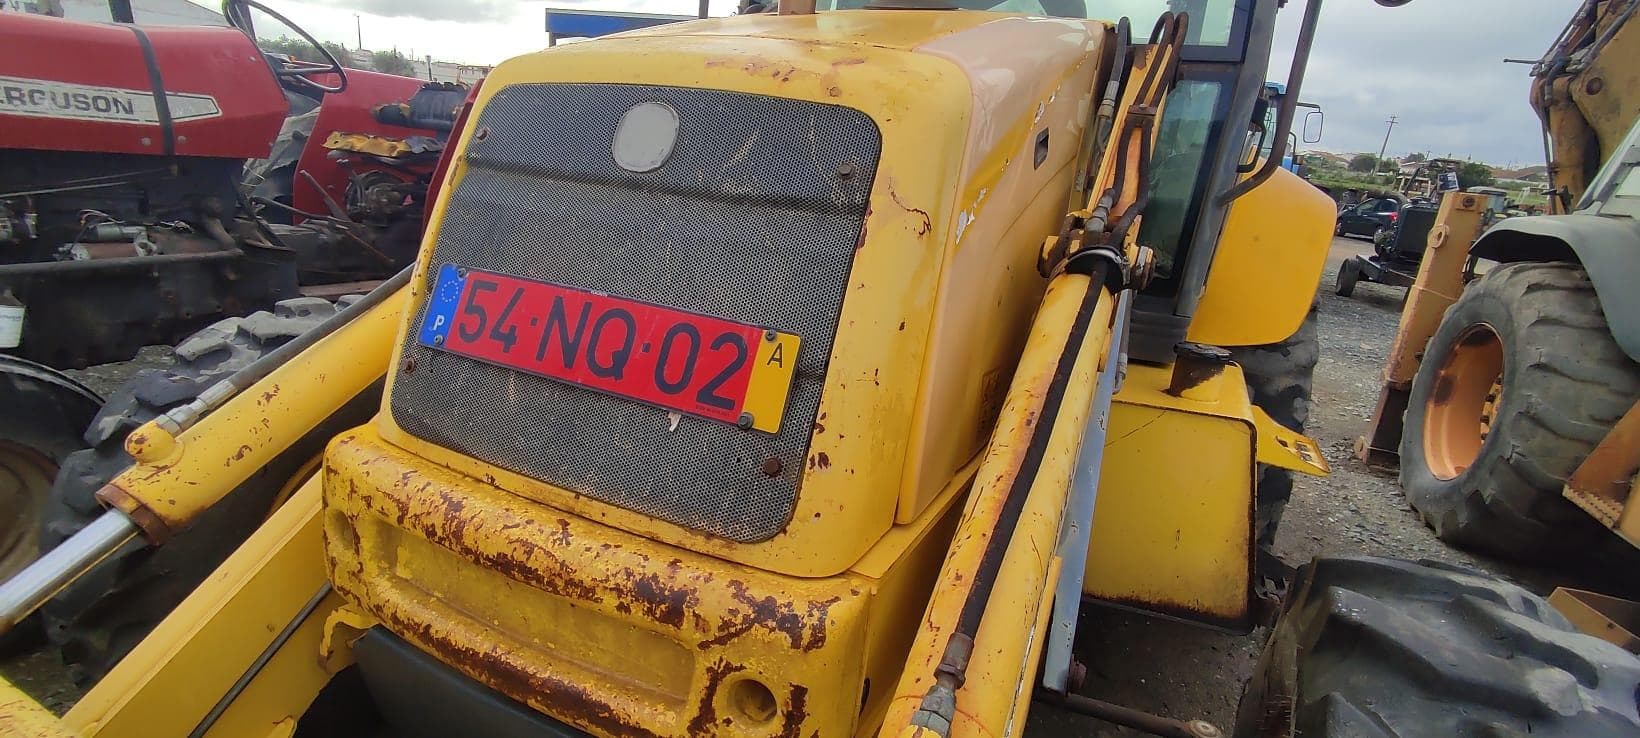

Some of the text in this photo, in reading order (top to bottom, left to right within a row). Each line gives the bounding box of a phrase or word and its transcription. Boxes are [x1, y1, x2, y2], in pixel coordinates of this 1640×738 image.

[0, 86, 134, 115] RGUSON
[432, 314, 445, 331] P
[766, 342, 783, 369] A
